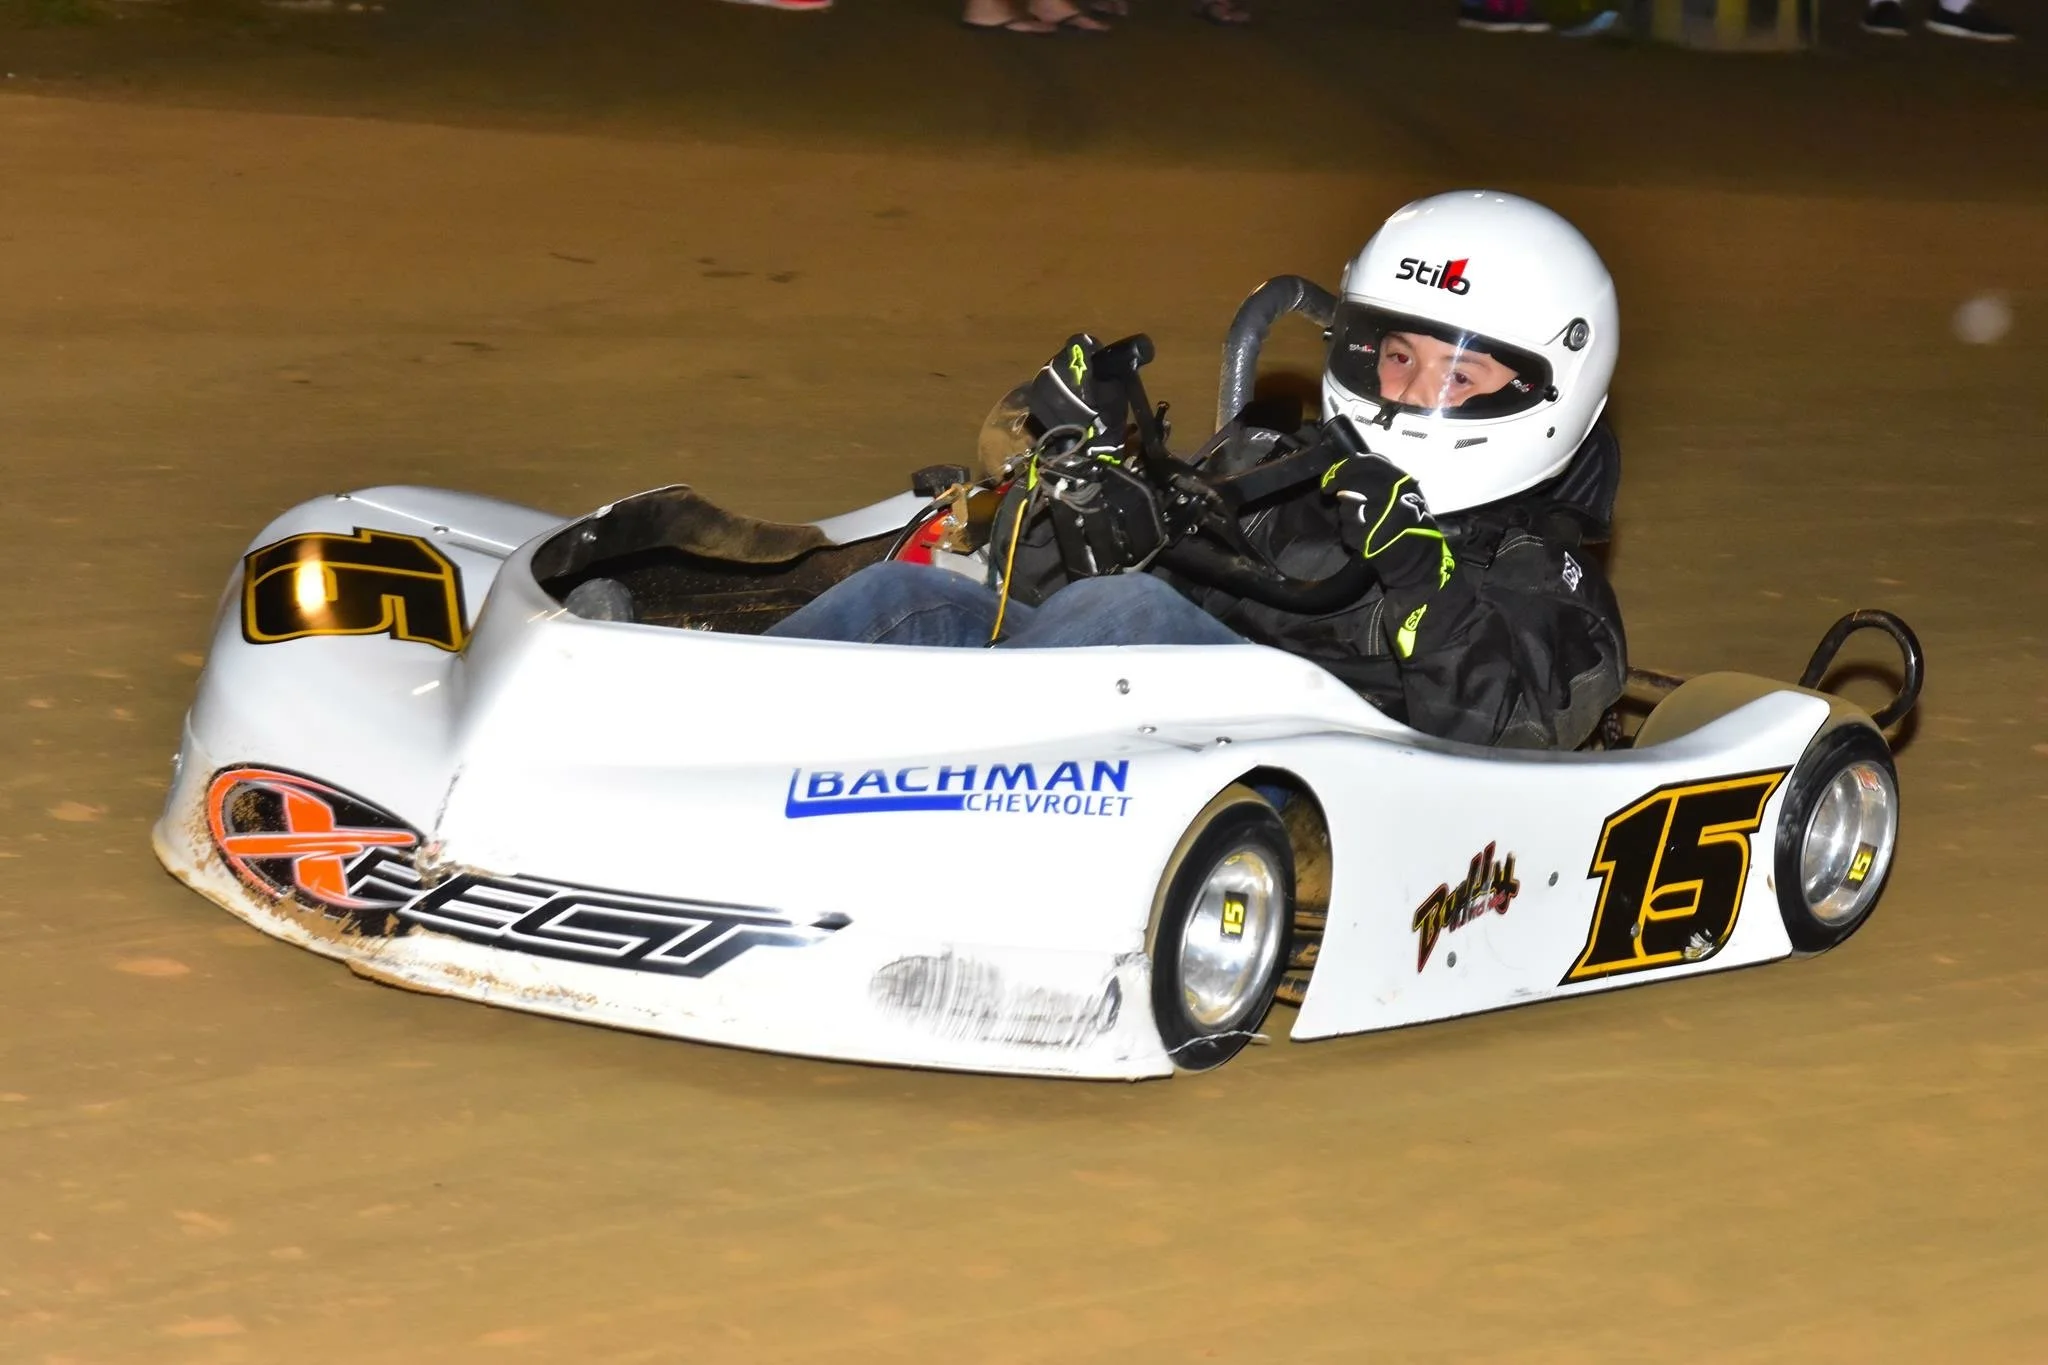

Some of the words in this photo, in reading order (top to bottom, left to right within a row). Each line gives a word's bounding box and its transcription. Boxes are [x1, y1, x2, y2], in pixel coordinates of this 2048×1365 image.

[1395, 257, 1471, 296] Stilo
[806, 760, 1130, 798] BACHMAN
[965, 792, 1133, 817] CHEVROLET
[1558, 765, 1793, 986] 15
[1847, 851, 1873, 881] 15
[1223, 900, 1245, 935] 15
